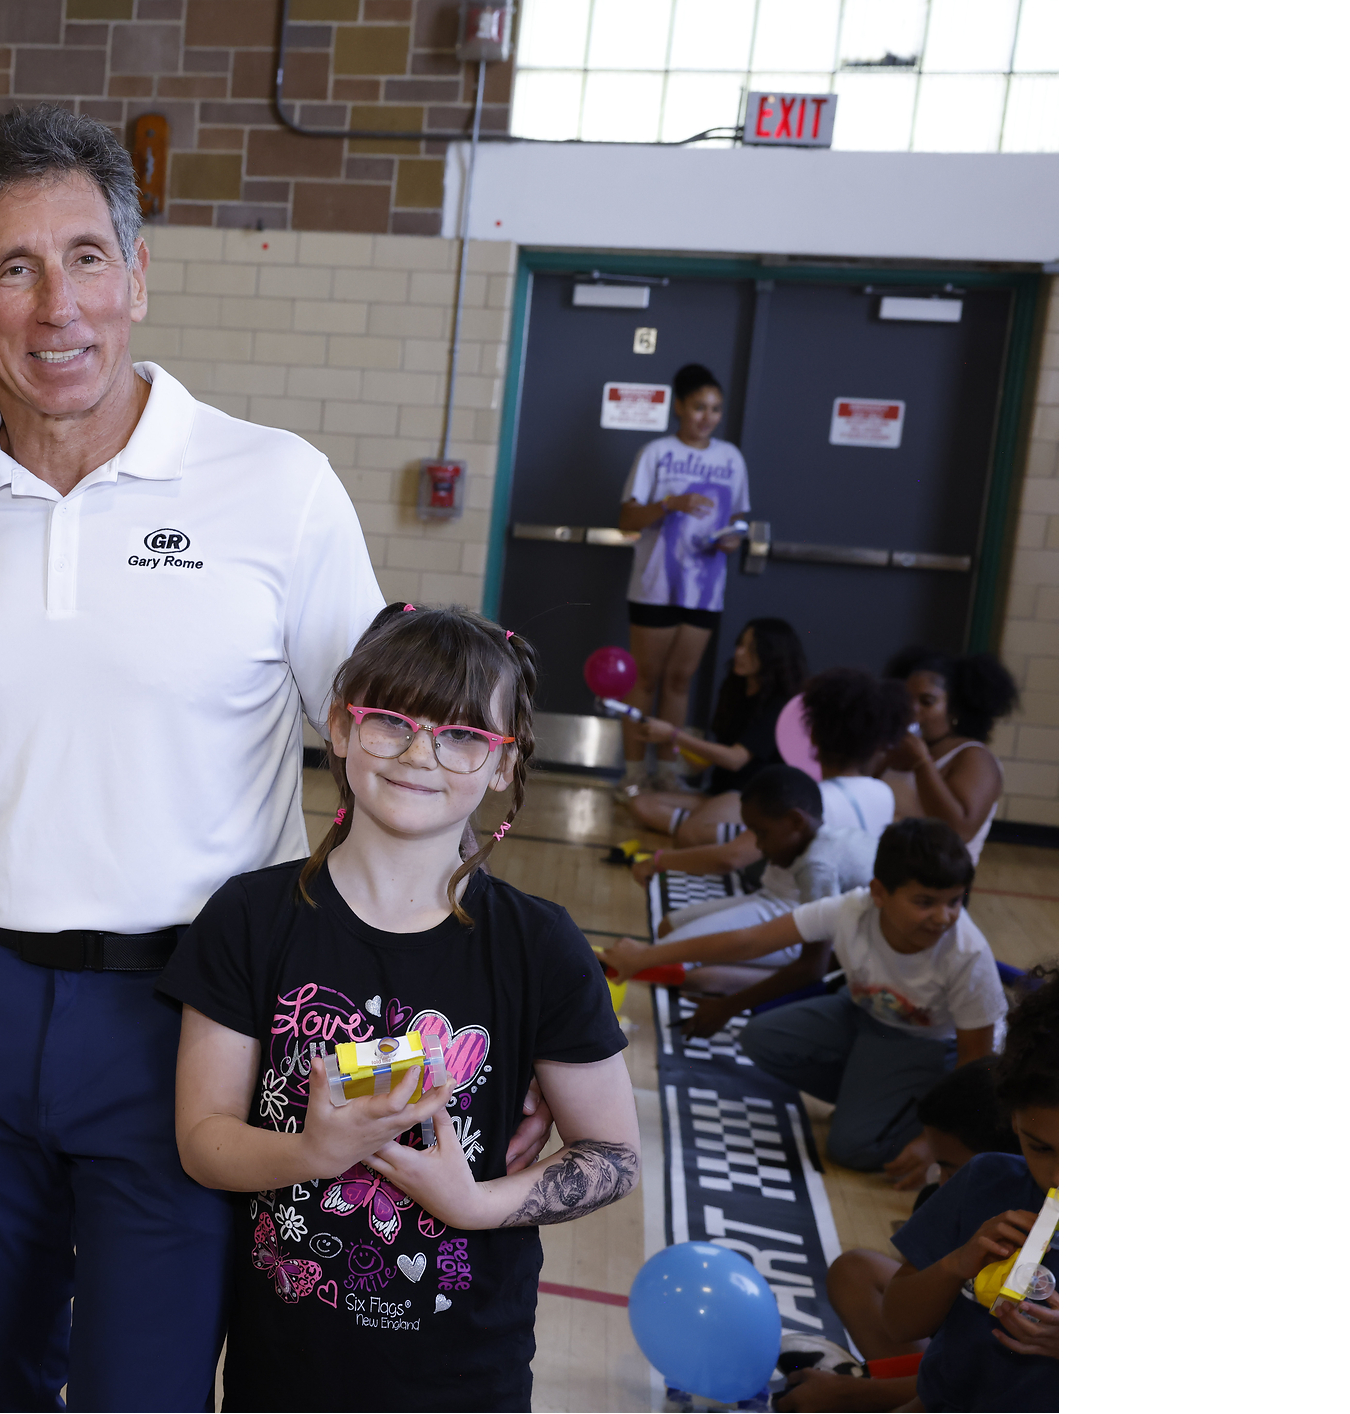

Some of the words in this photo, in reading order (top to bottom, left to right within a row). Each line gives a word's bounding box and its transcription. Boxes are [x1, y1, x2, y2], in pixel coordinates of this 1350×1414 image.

[755, 96, 829, 139] EXIT
[151, 533, 183, 550] GR
[128, 555, 161, 570] Gary
[163, 555, 204, 569] Rome
[270, 983, 375, 1042] Love
[704, 1205, 824, 1340] ART
[345, 1292, 366, 1312] Six
[381, 1316, 421, 1331] England
